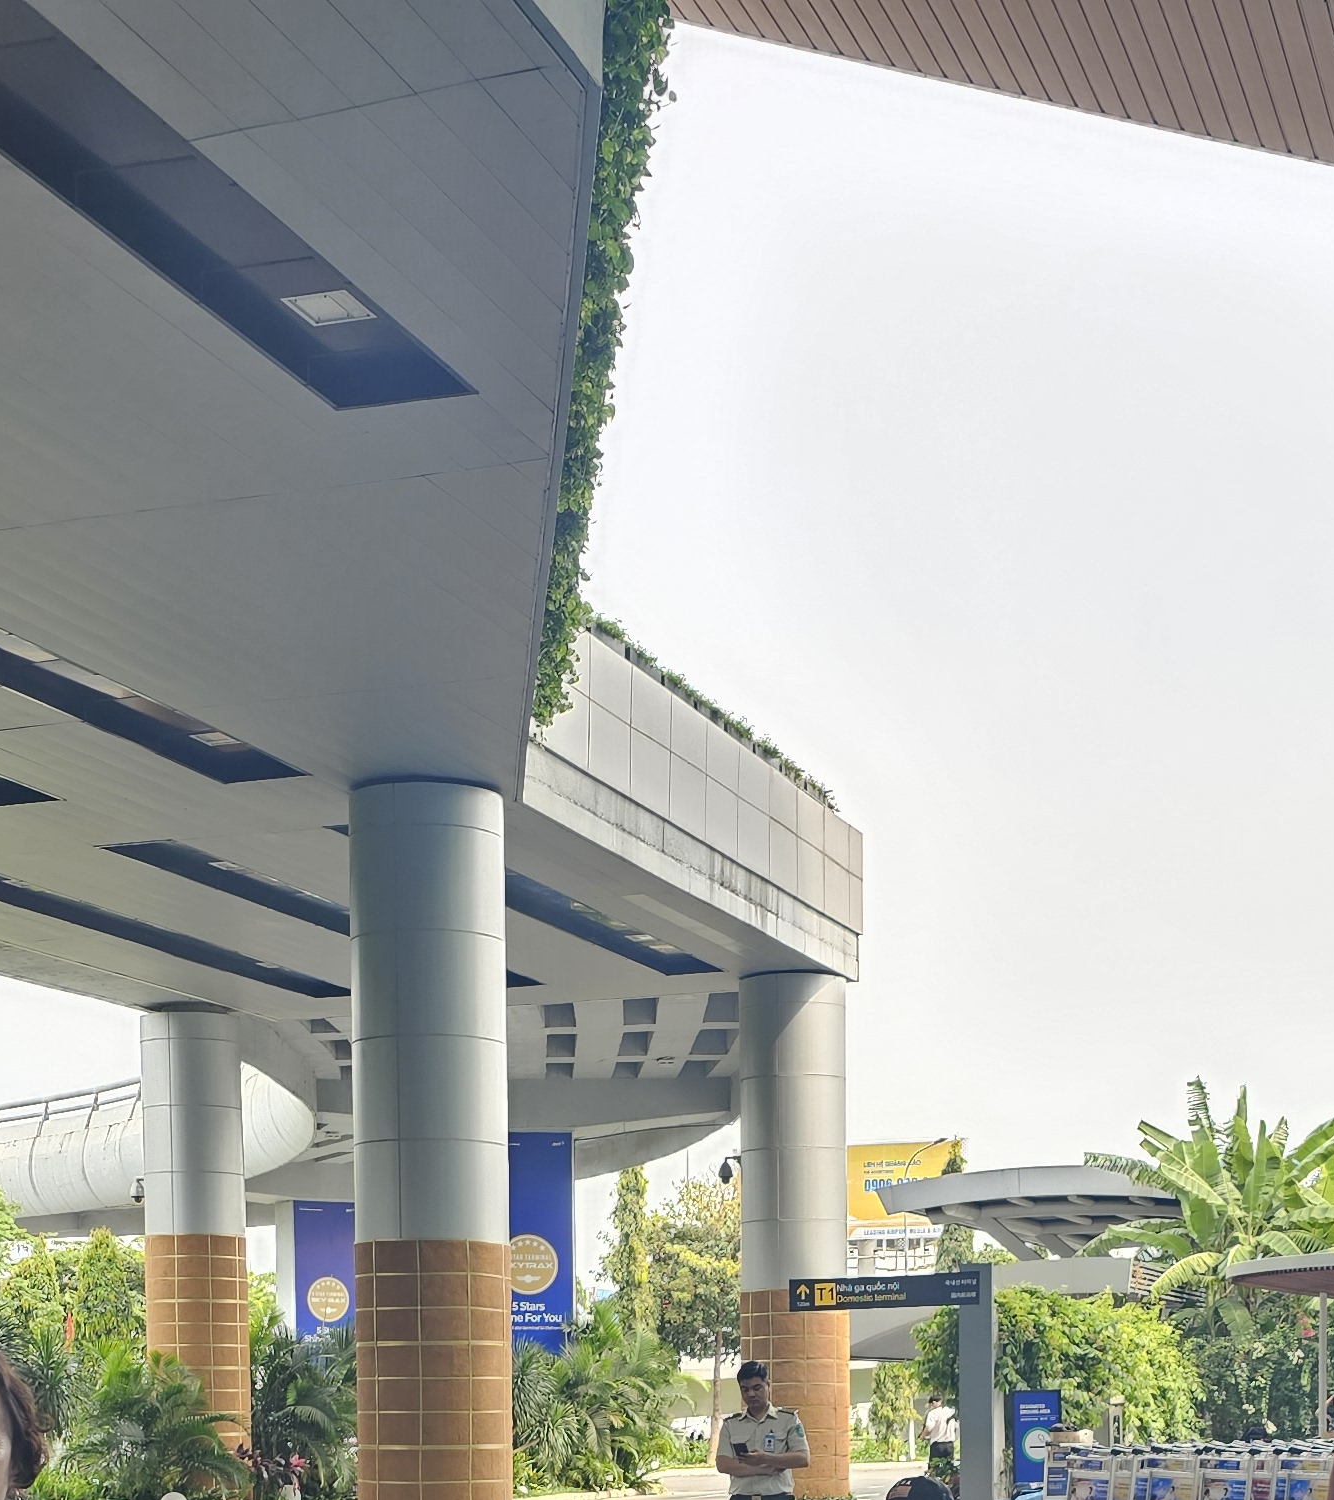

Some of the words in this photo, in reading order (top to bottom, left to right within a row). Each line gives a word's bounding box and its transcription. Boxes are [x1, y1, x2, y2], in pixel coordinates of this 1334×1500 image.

[816, 1286, 835, 1301] T1
[854, 1285, 865, 1293] ga
[836, 1294, 874, 1303] Domestic
[874, 1292, 907, 1301] terminal
[519, 1302, 546, 1311] Stars
[525, 1313, 542, 1323] For
[543, 1313, 563, 1323] You
